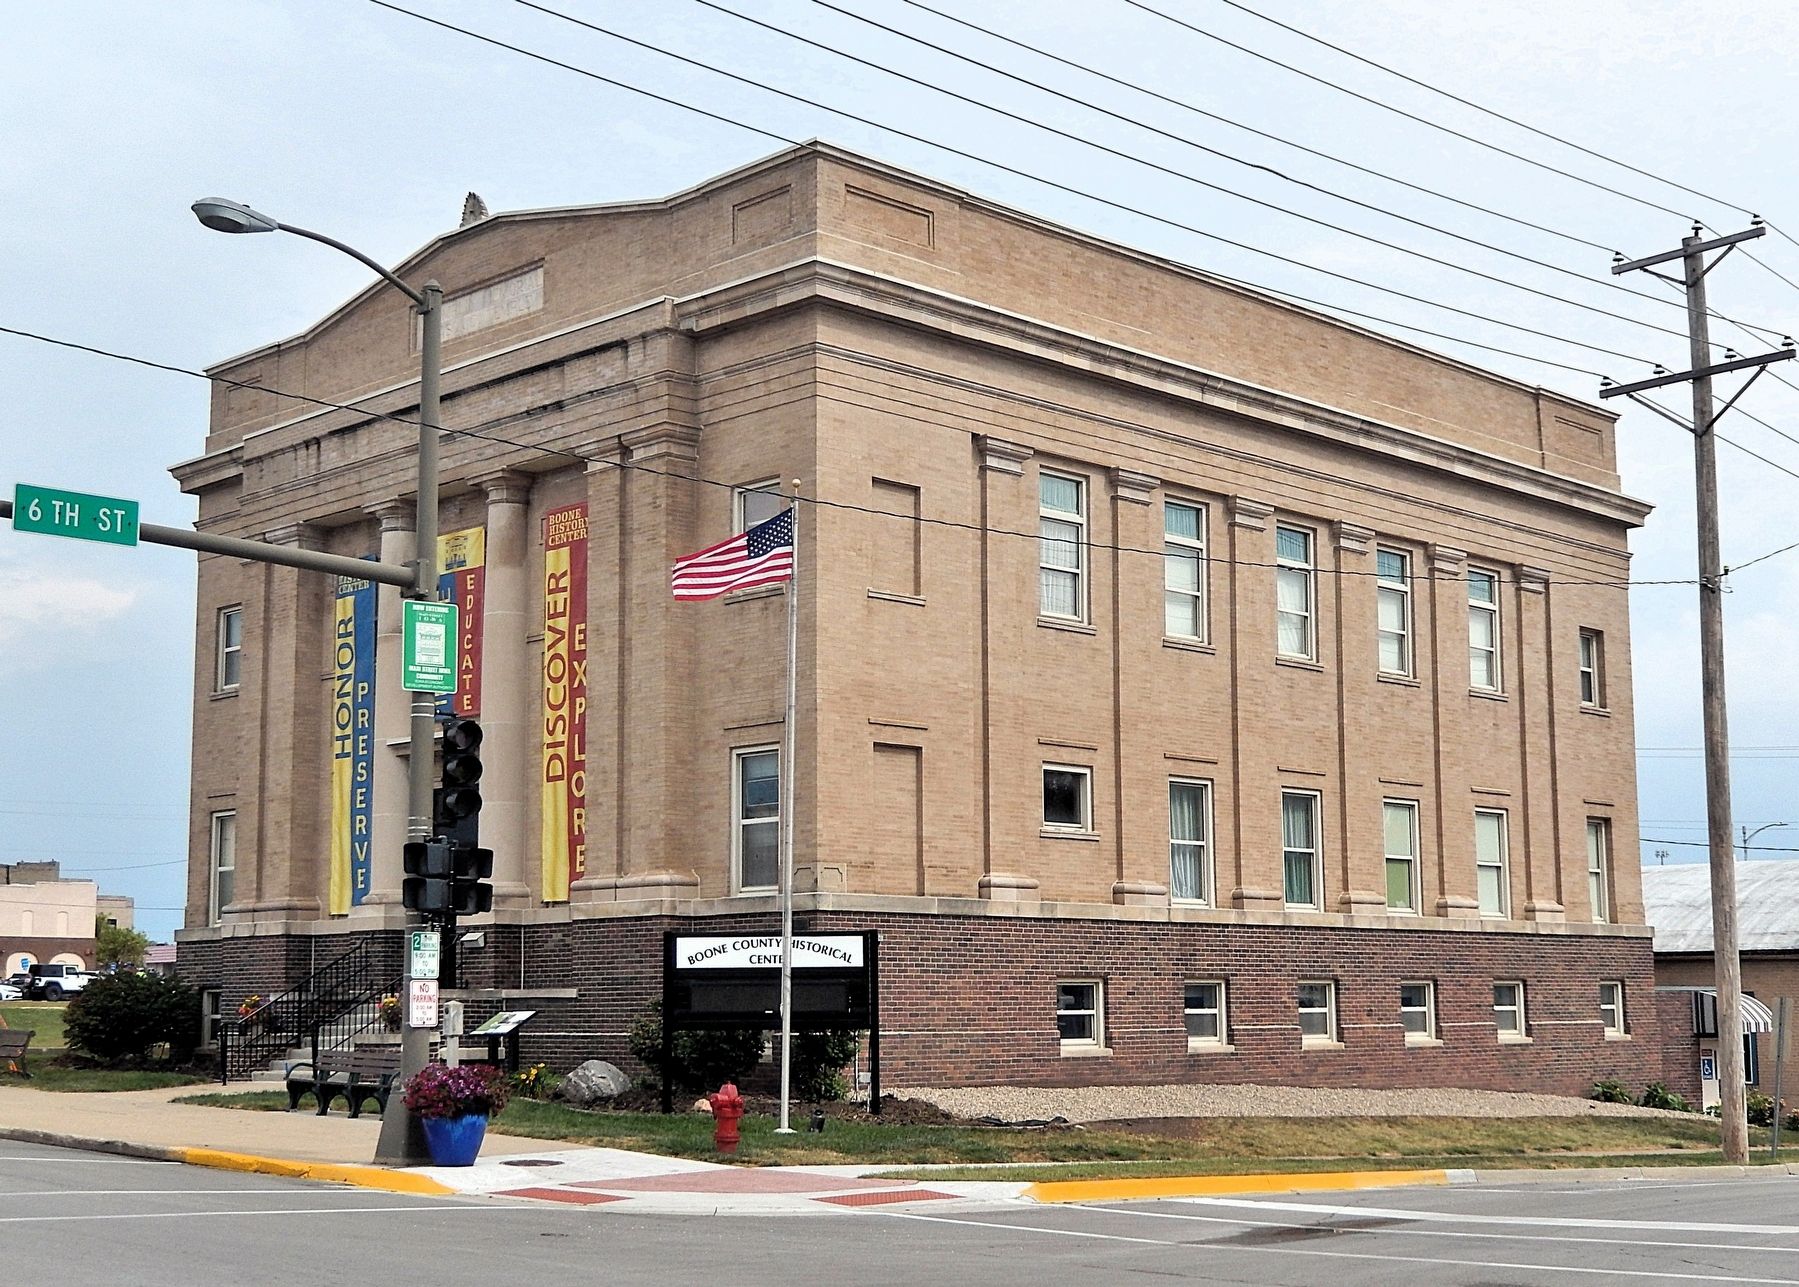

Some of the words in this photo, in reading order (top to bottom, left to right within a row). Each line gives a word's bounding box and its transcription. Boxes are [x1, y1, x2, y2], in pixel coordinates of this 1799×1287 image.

[28, 498, 42, 521] 6
[98, 508, 125, 532] ST
[549, 508, 581, 525] BOONE
[549, 529, 587, 546] CENTER
[338, 580, 369, 594] CENTER
[461, 575, 475, 711] EDUCATE
[546, 569, 568, 783] DISCOVER
[335, 616, 354, 759] HONOR
[570, 623, 587, 873] EXPLORE
[354, 682, 369, 889] PRESERVE
[414, 936, 420, 948] 2
[687, 944, 728, 965] BOONE
[732, 938, 782, 951] COUNTY
[749, 954, 783, 965] CENTE
[413, 995, 436, 1003] PARKING
[419, 985, 429, 993] NO
